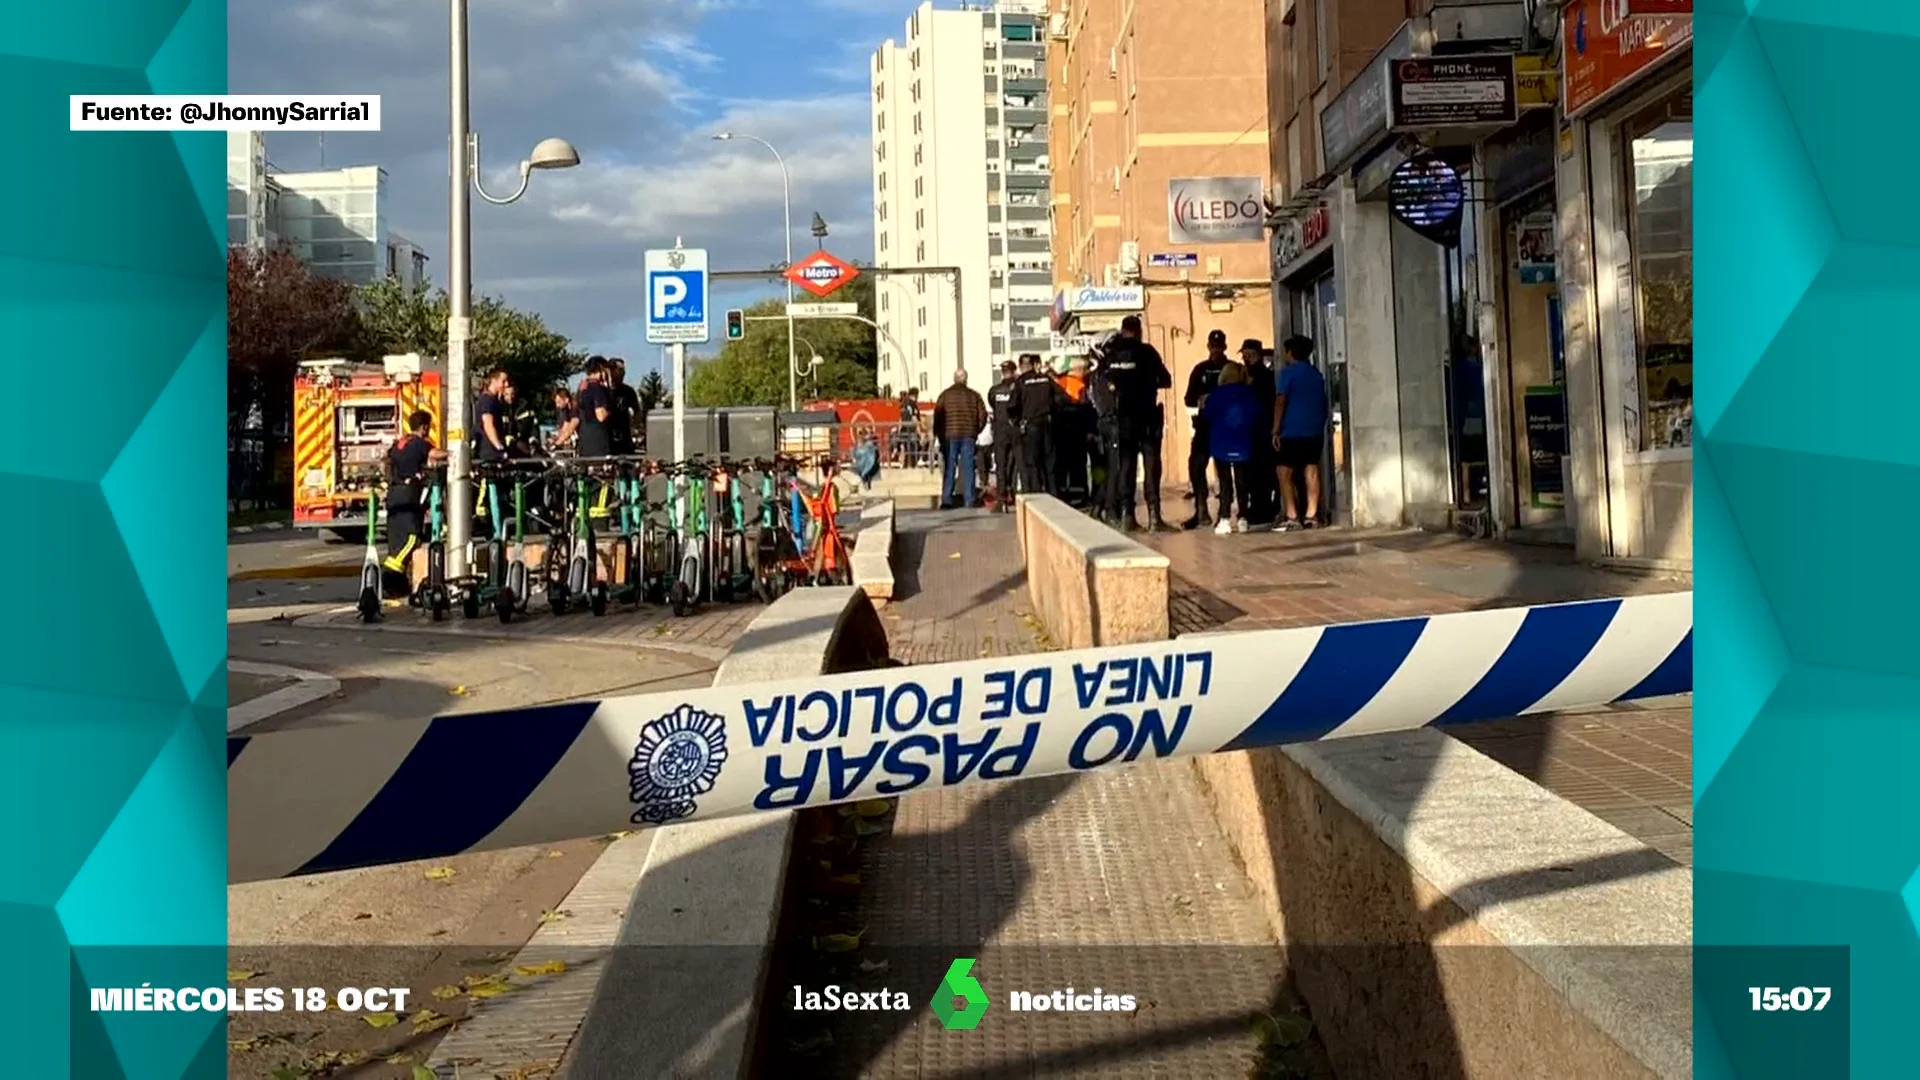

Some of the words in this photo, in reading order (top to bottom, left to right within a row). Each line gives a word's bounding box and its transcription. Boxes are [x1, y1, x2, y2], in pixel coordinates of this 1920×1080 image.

[1433, 63, 1472, 75] PHONE
[1189, 194, 1260, 221] LLEDÓ
[654, 276, 688, 319] P
[805, 267, 838, 279] Metro
[980, 667, 1052, 721] DE
[1072, 651, 1213, 709] LINEA
[742, 677, 963, 747] POLICIA
[1068, 704, 1193, 770] NO
[753, 722, 1042, 810] PASAR
